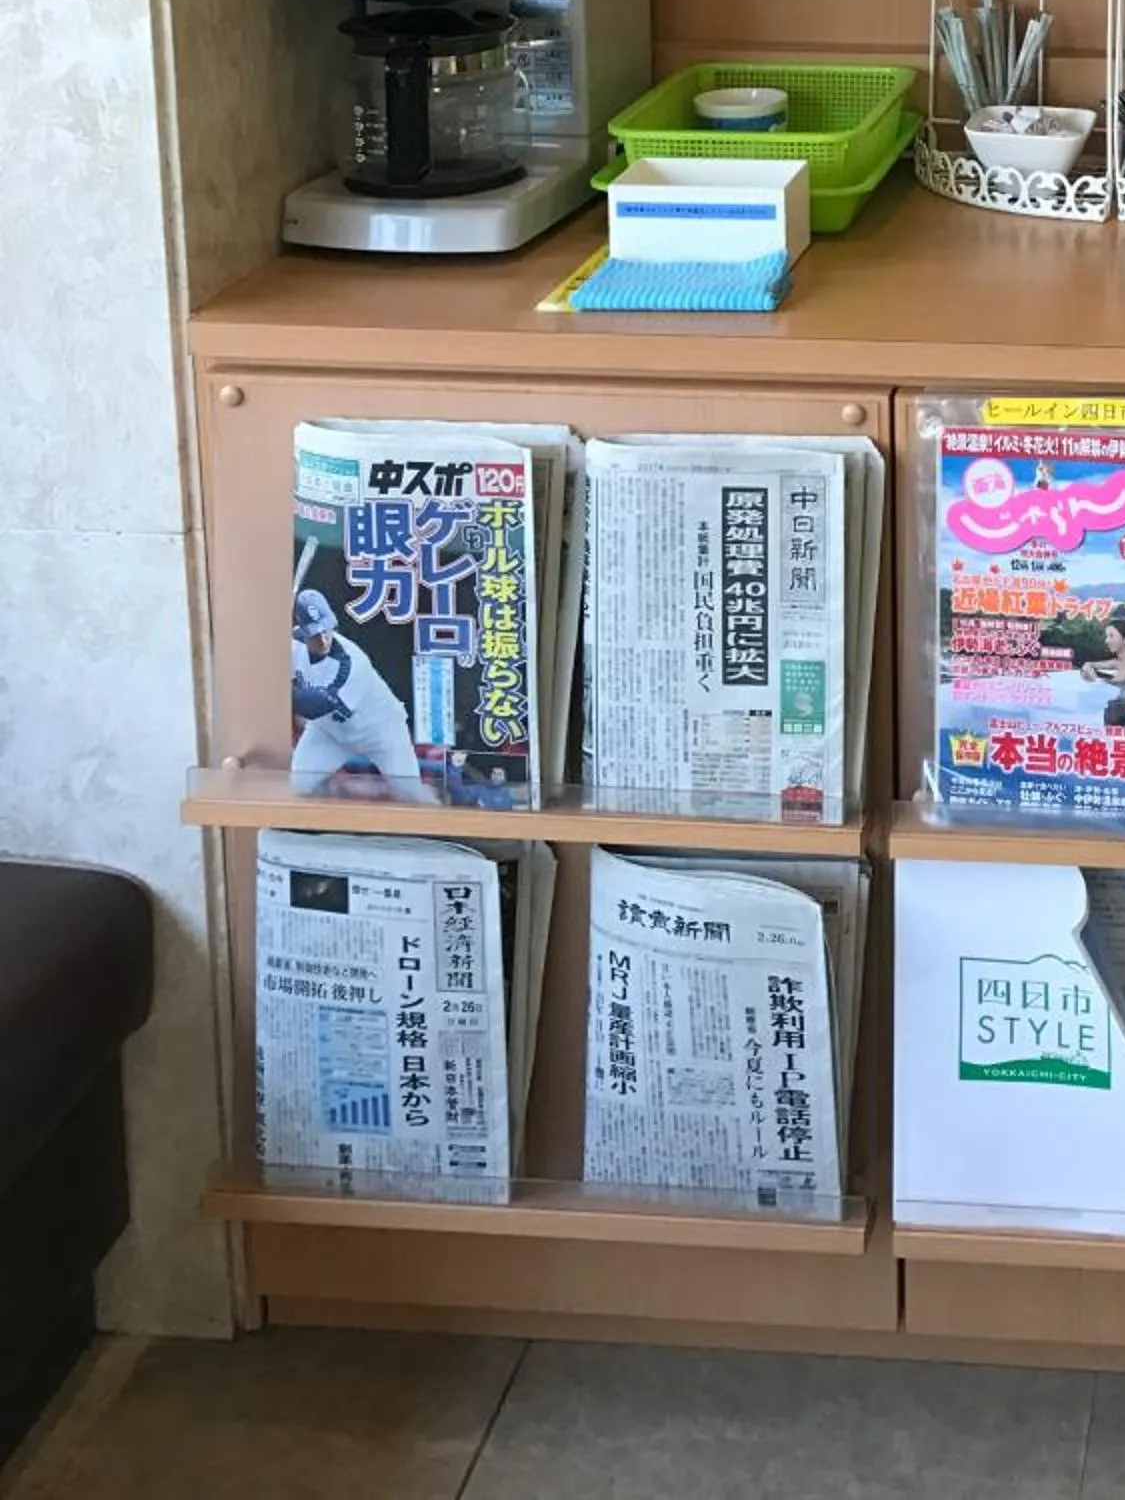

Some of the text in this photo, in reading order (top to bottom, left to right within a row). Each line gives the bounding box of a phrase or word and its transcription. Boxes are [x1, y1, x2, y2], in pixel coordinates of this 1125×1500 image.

[368, 459, 473, 497] 中スポ
[345, 500, 418, 626] 眼力
[788, 485, 821, 594] 中日新聞
[478, 500, 527, 747] ボール球は振らない
[262, 972, 383, 1005] 市場開拓 後押し
[442, 885, 476, 991] 日本経済新聞
[396, 935, 432, 1128] ドローン規格 日本から
[977, 977, 1092, 1017] 四日市
[977, 1015, 1096, 1052] STYLE
